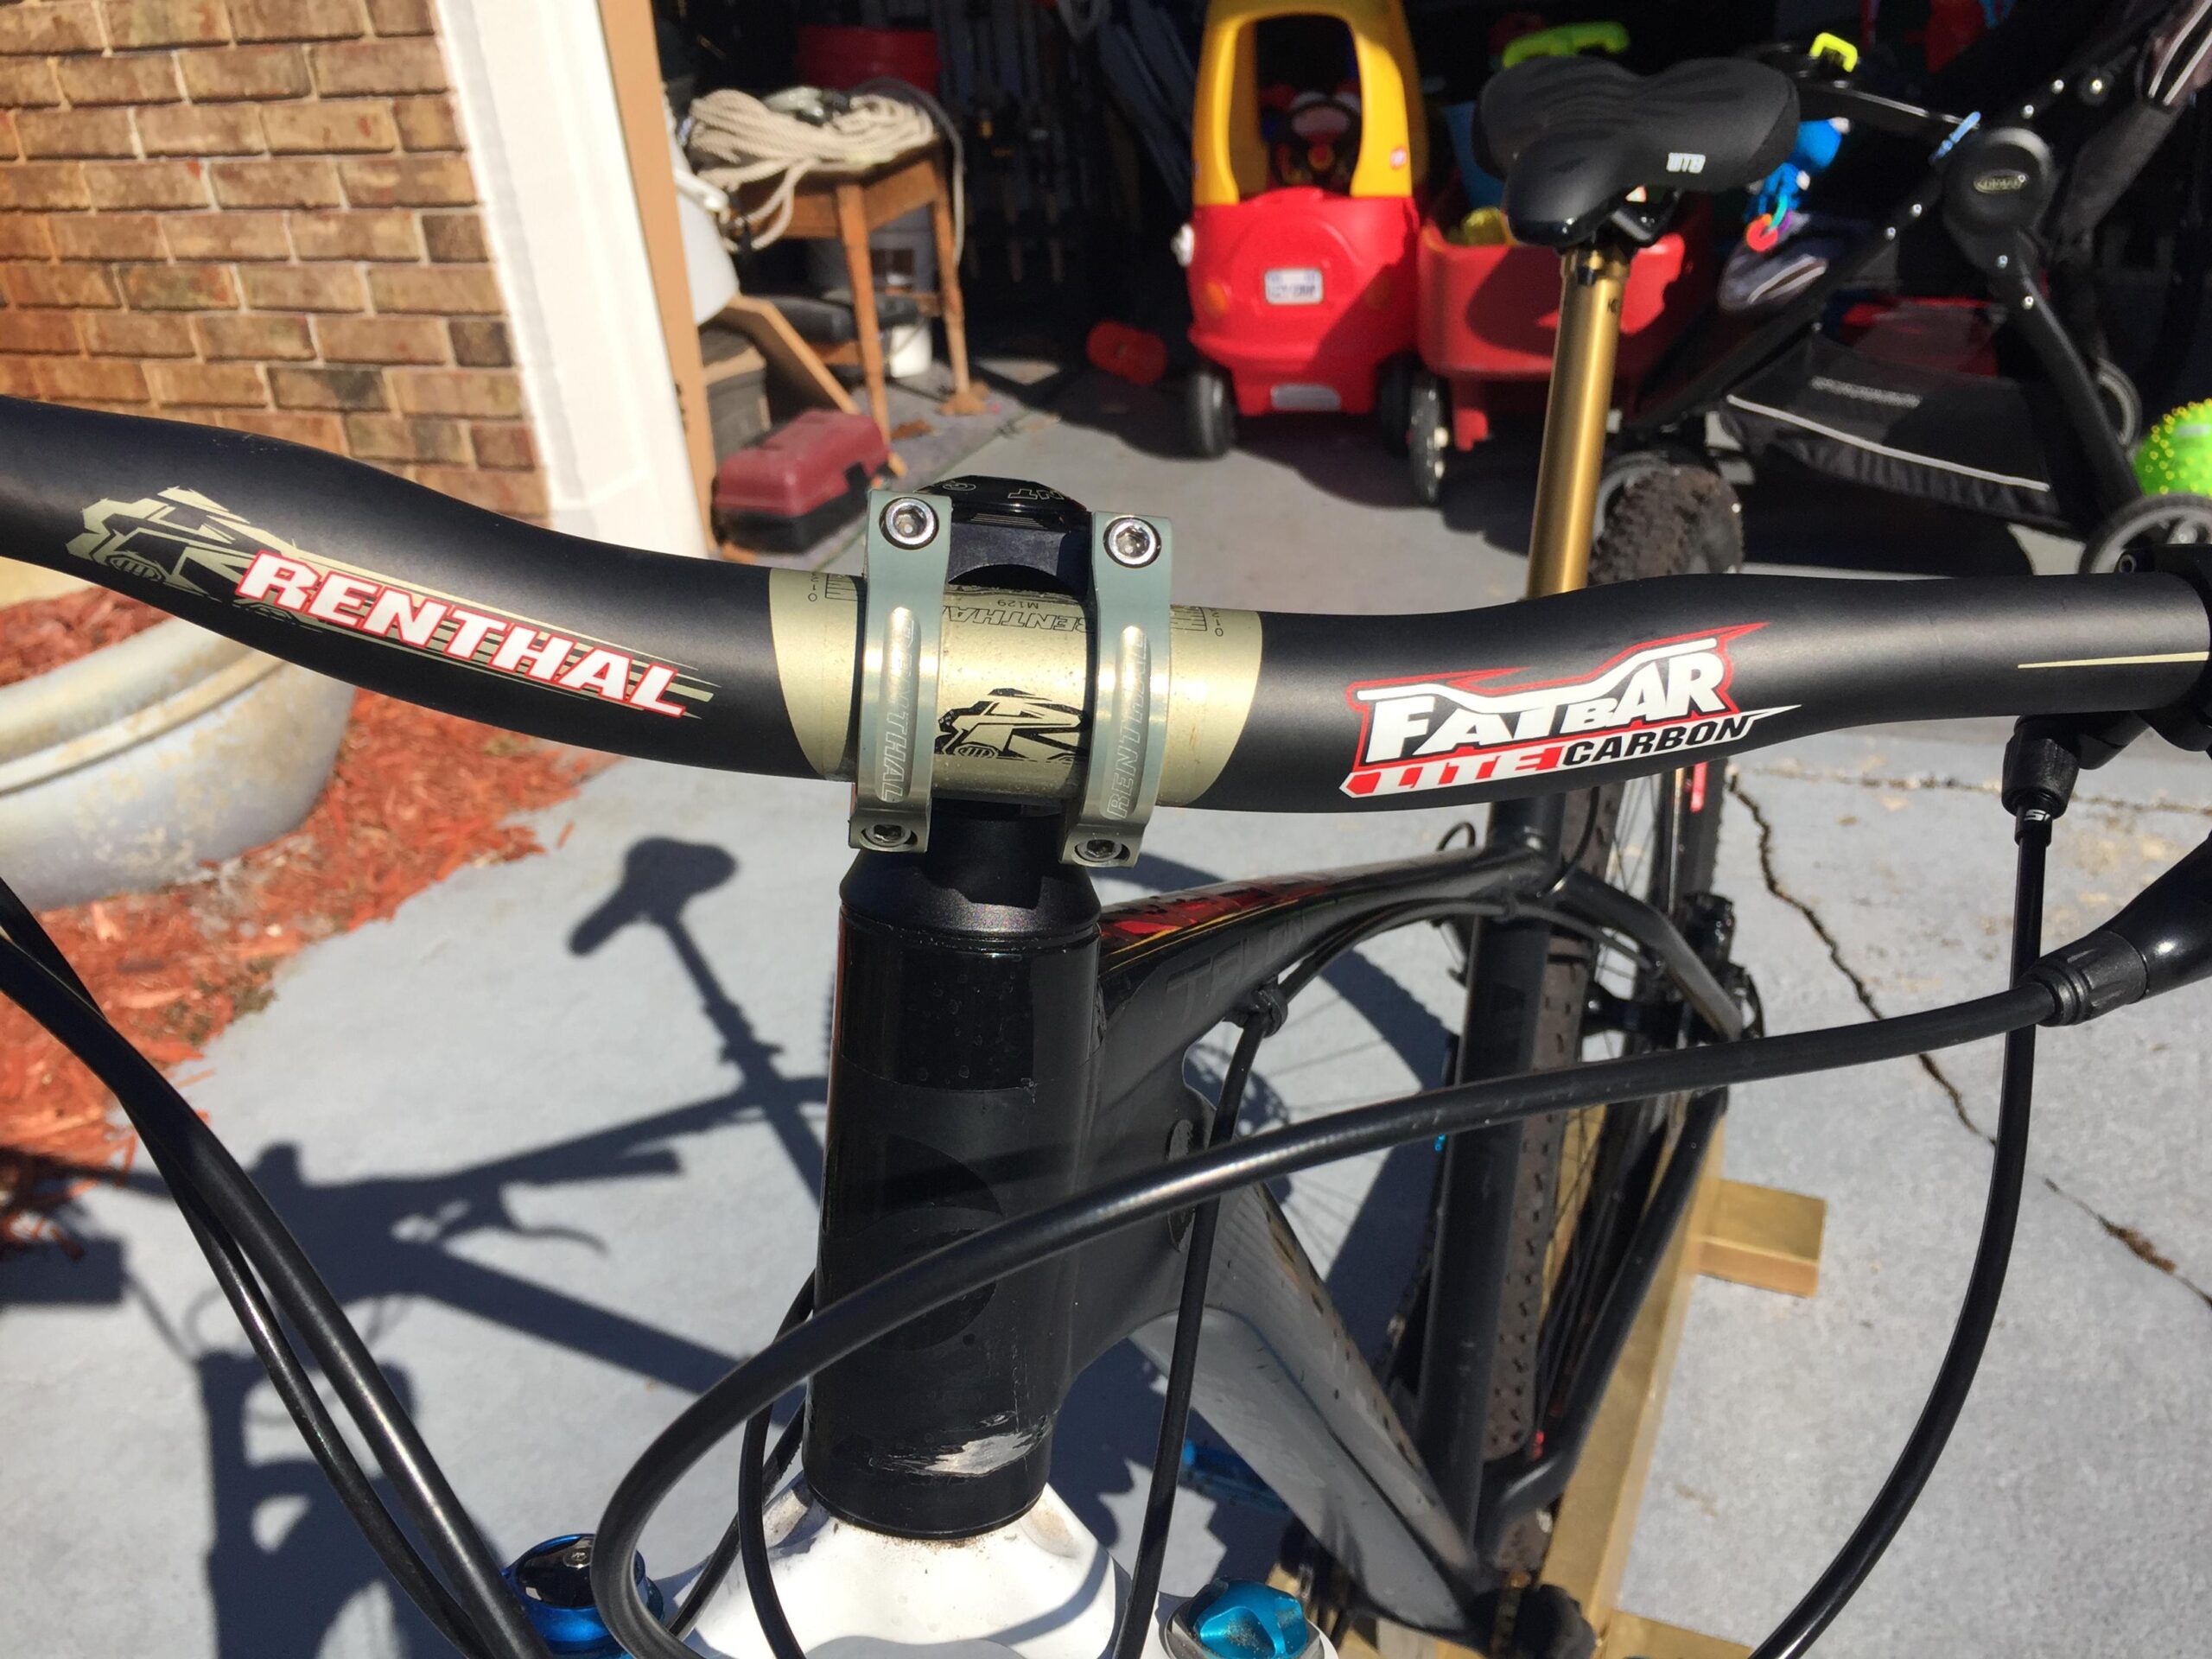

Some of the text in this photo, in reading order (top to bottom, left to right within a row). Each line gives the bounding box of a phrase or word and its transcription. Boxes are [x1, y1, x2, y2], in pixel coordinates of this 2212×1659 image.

[942, 604, 1096, 634] RENTHA
[997, 599, 1039, 610] M129
[235, 550, 686, 718] RENTHAL
[1363, 648, 1727, 764] FATBAR
[1561, 715, 1752, 767] CARBON
